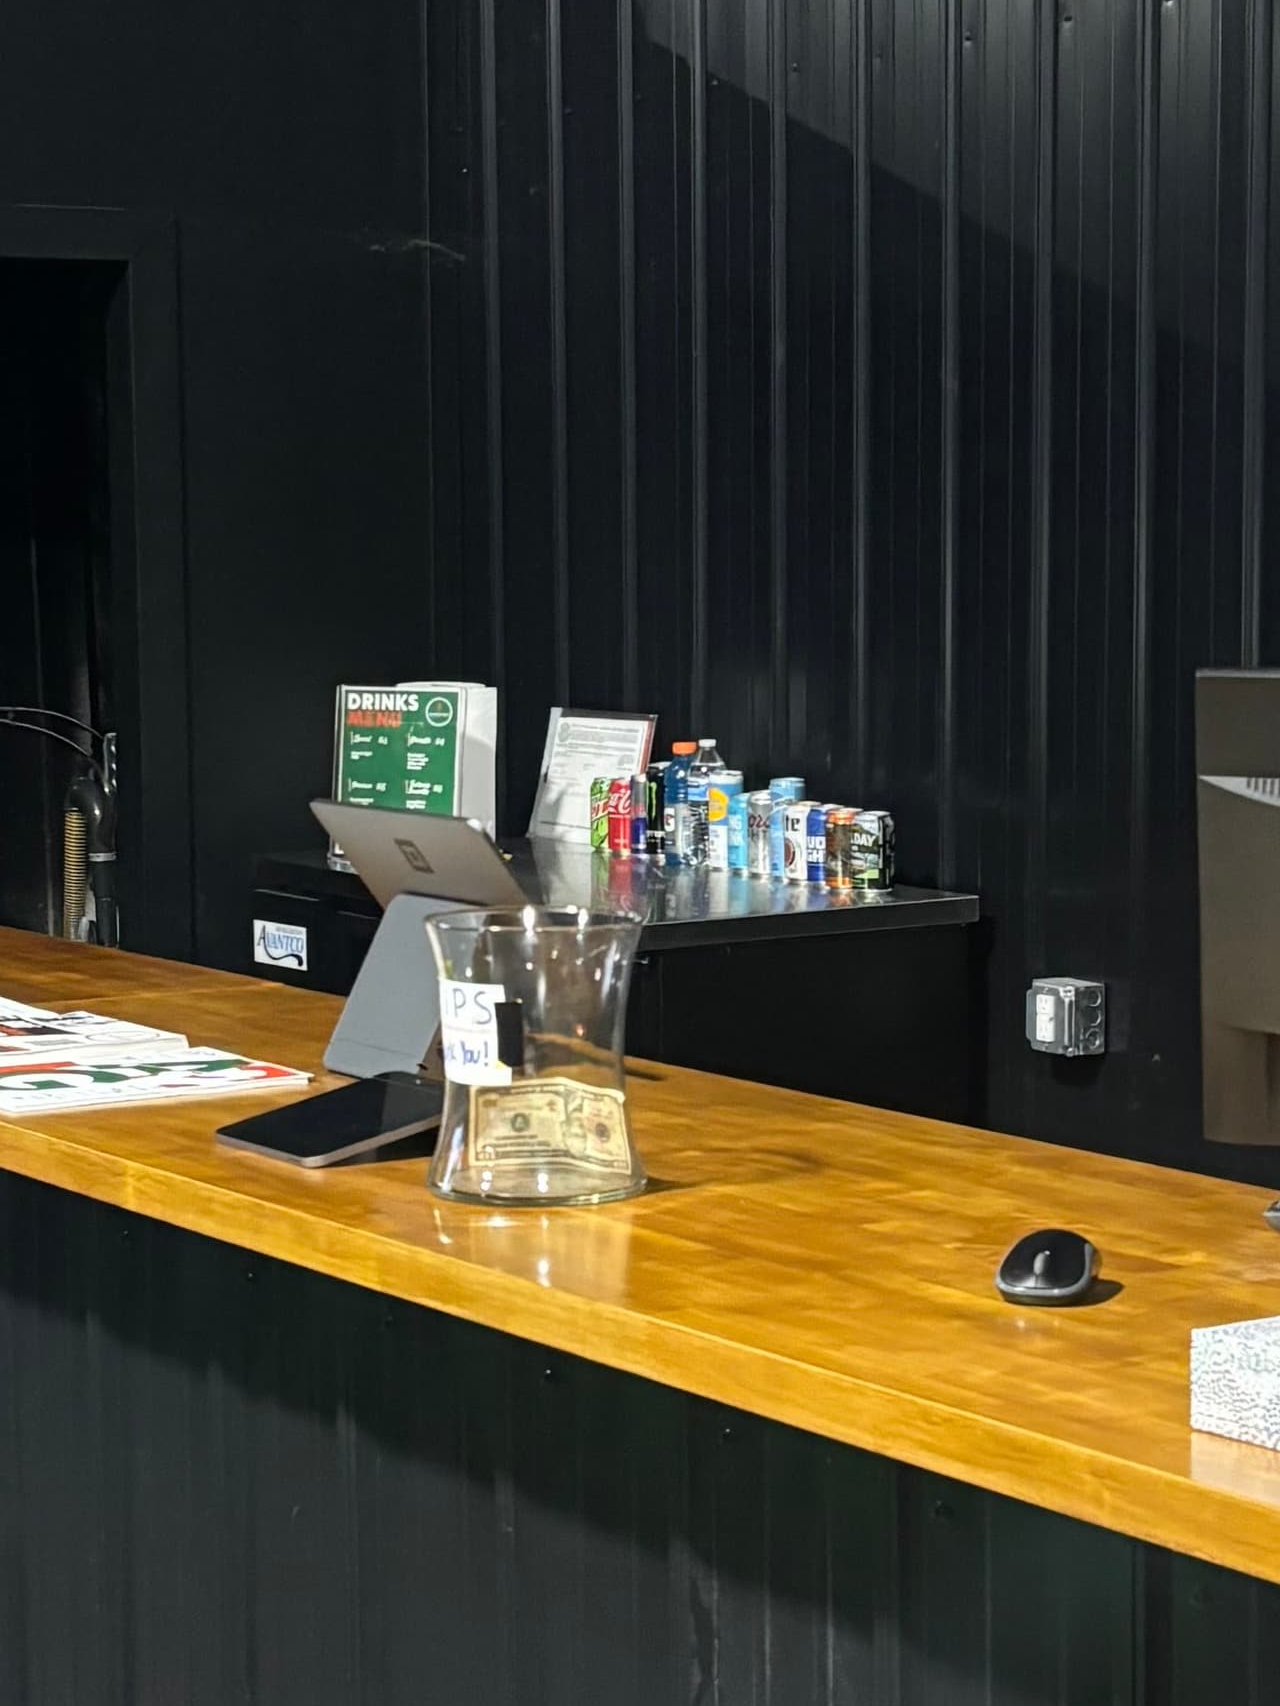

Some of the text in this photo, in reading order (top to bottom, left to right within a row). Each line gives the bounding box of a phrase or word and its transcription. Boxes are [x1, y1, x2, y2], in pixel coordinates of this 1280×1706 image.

[347, 693, 419, 711] DRINKS
[347, 710, 402, 728] MENU
[807, 836, 826, 849] UD
[854, 833, 876, 847] DAY
[445, 987, 492, 1025] IPS
